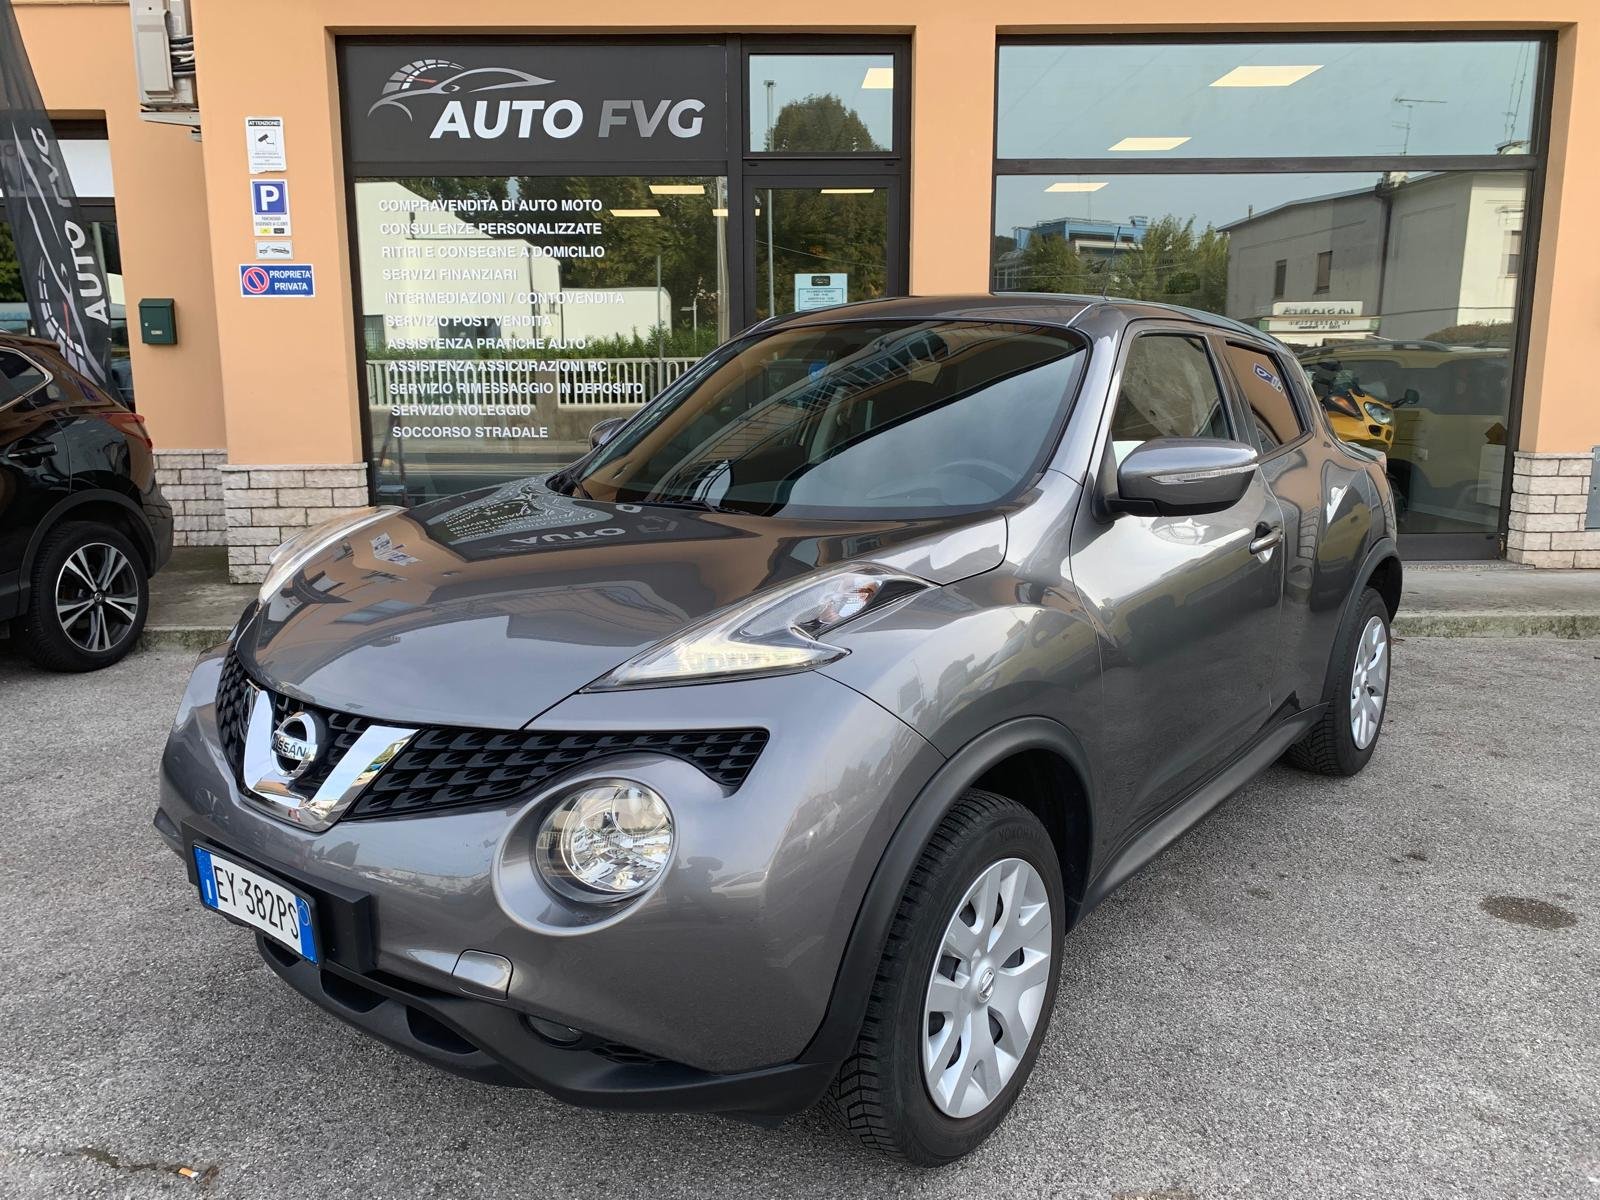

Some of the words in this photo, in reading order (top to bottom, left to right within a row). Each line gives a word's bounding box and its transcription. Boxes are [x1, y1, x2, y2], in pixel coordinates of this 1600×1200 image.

[429, 100, 584, 139] AUTO
[598, 99, 706, 138] FVG
[259, 185, 280, 211] P
[379, 199, 498, 211] COMPRAVENDITA
[501, 199, 515, 211] DI
[519, 199, 557, 211] AUTO
[561, 199, 602, 211] MOTO
[380, 222, 474, 235] CONSULENZE
[478, 222, 602, 235] PERSONALIZZATE
[382, 246, 421, 258] RITIRI
[425, 246, 434, 258] E
[439, 246, 516, 258] CONSEGNE
[520, 246, 530, 258] A
[534, 245, 605, 258] DOMICILIO
[64, 220, 110, 325] AUTO
[269, 270, 312, 279] PROPRIETA'
[383, 268, 437, 280] SERVIZI
[440, 268, 517, 280] FINANZIARI
[274, 282, 309, 291] PRIVATA
[385, 292, 506, 304] INTERMEDIAZIONI
[517, 292, 626, 304] CONTOVENDITA
[386, 315, 449, 327] SERVIZIO
[453, 315, 490, 327] POST
[494, 315, 553, 327] VENDITA
[387, 338, 473, 350] ASSISTENZA
[477, 338, 545, 350] PRATICHE
[548, 338, 586, 350] AUTO
[389, 361, 474, 372] ASSISTENZA
[477, 361, 585, 372] ASSICURAZIONI
[588, 361, 607, 372] RC
[390, 383, 453, 394] SERVIZIO
[457, 382, 554, 394] RIMESSAGGIO
[558, 382, 571, 394] IN
[576, 382, 643, 394] DEPOSITO
[391, 405, 454, 416] SERVIZIO
[458, 404, 531, 416] NOLEGGIO
[392, 427, 472, 438] SOCCORSO
[475, 427, 548, 438] STRADALE
[213, 865, 237, 907] EY
[241, 877, 299, 940] 382PS
